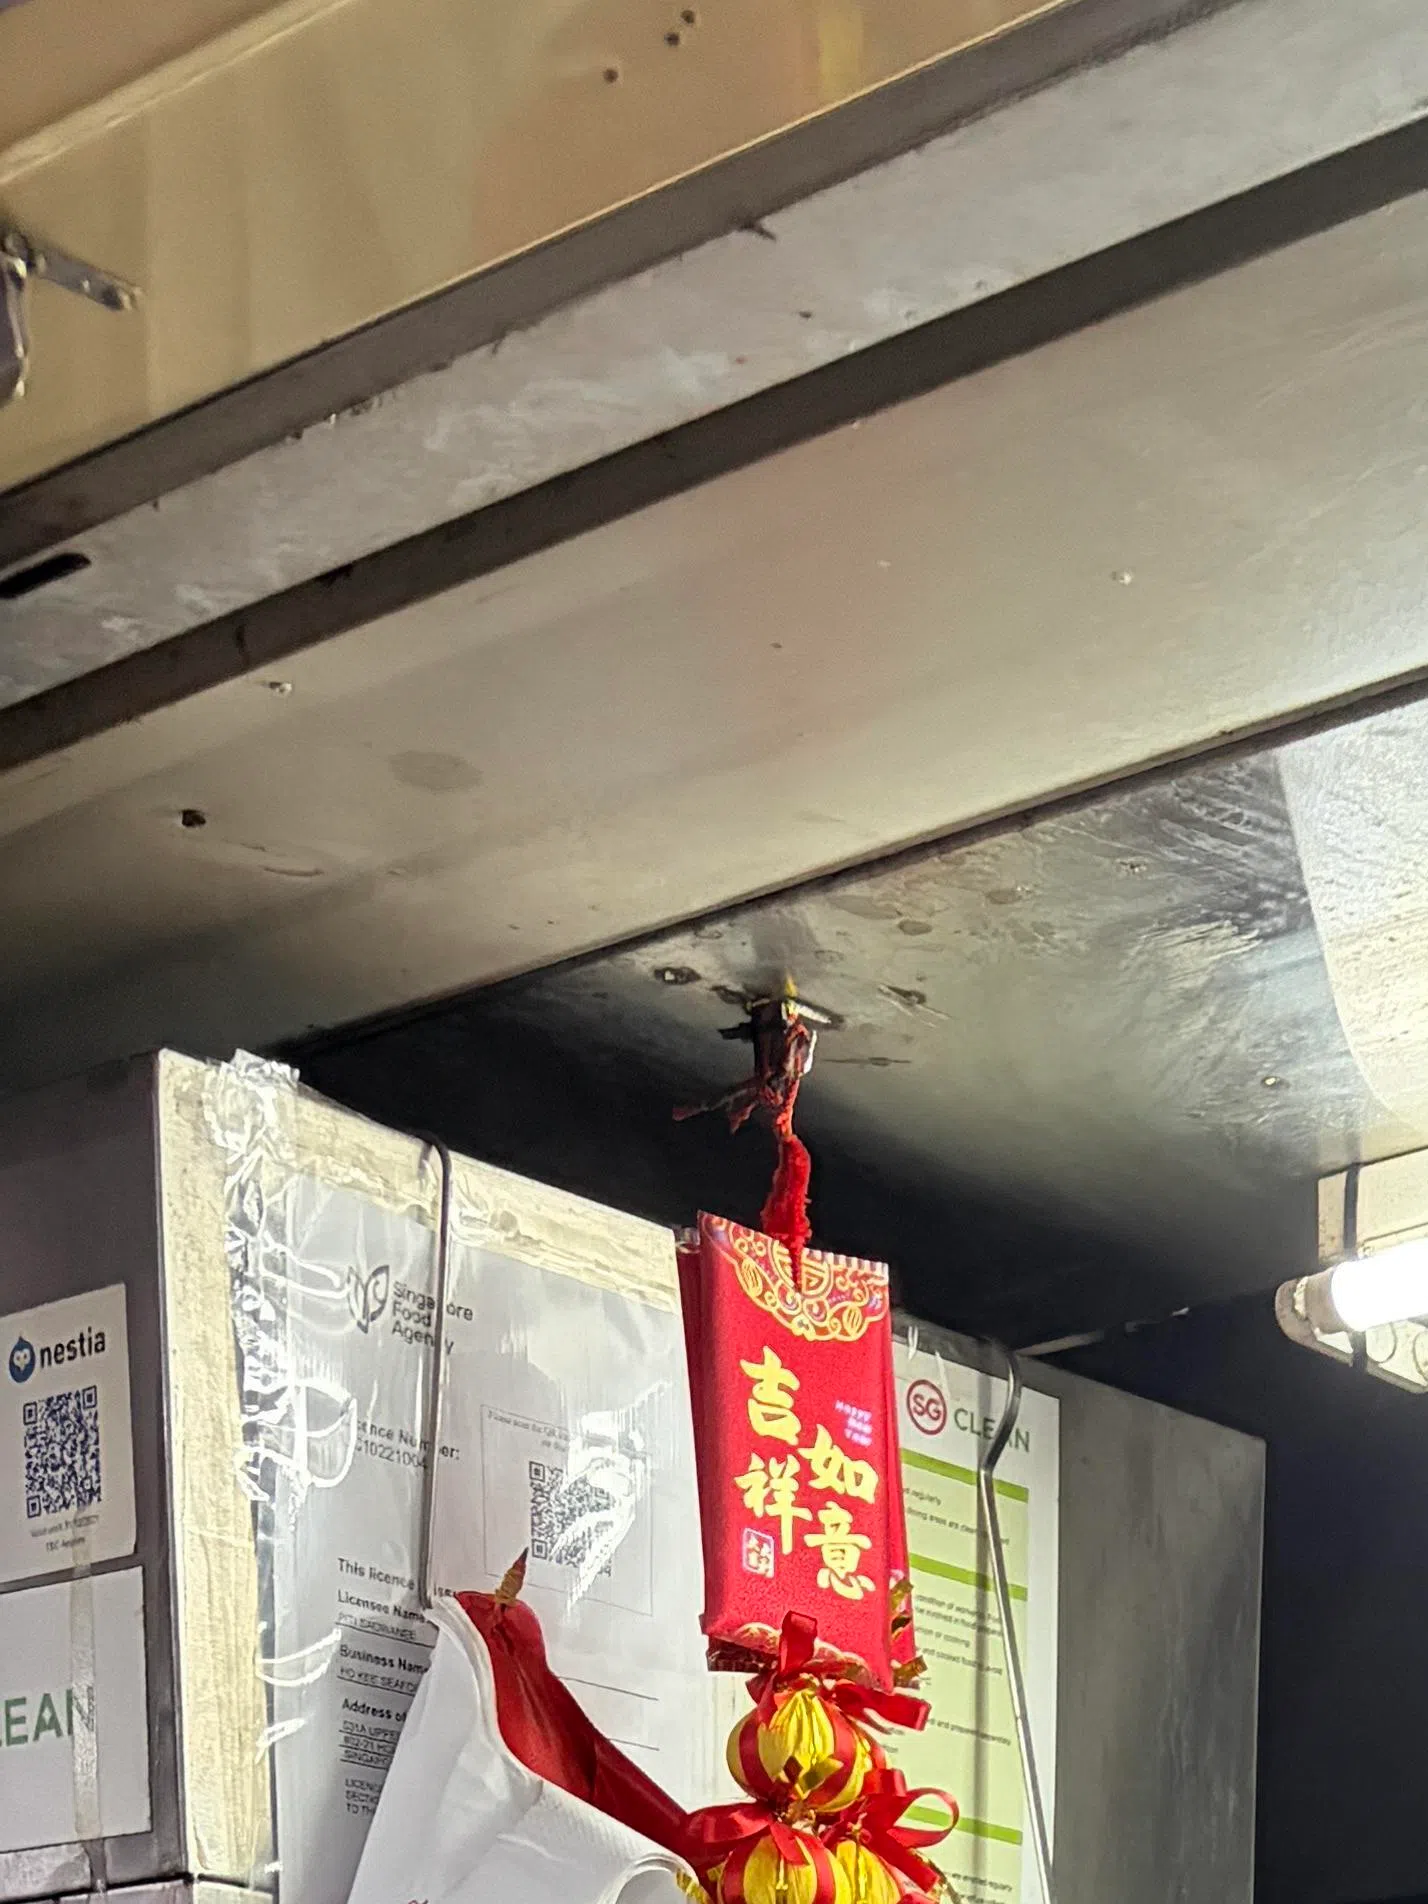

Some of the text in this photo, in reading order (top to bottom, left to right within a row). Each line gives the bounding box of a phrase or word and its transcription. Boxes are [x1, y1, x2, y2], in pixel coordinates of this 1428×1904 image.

[391, 1300, 432, 1327] Food
[392, 1281, 474, 1321] Singaore
[40, 1327, 106, 1369] nestia
[391, 1321, 455, 1355] Ageny
[912, 1393, 1030, 1453] SG CLEN
[399, 1429, 460, 1461] Numer:
[733, 1345, 813, 1555] 吉祥
[798, 1424, 879, 1600] 如意
[338, 1557, 415, 1590] This licence
[338, 1589, 390, 1614] Licensee
[339, 1643, 395, 1669] Business
[0, 1685, 96, 1747] EAN
[342, 1698, 392, 1720] Address
